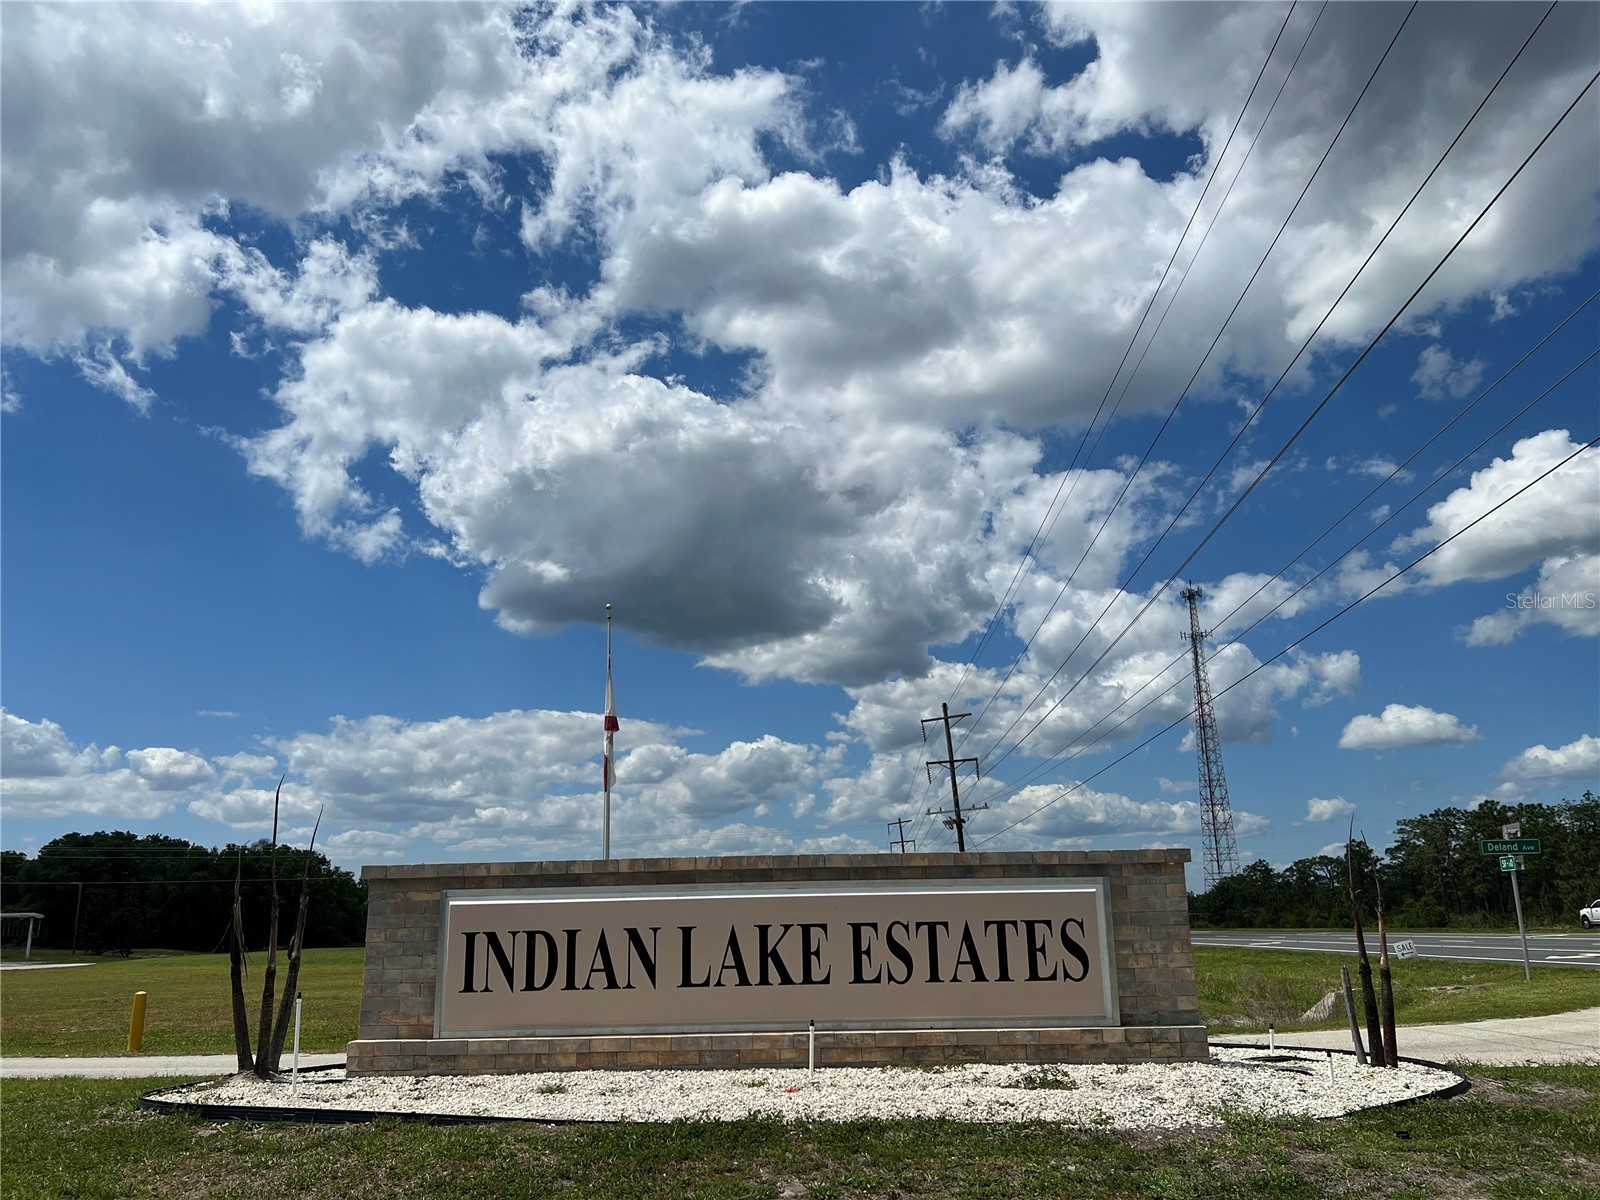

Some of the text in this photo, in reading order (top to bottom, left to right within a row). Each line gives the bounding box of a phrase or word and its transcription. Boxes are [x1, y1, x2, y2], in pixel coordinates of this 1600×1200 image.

[1487, 843, 1518, 851] Deland
[1396, 942, 1413, 953] SALE
[458, 917, 1090, 994] INDIAN LAKE ESTATES
